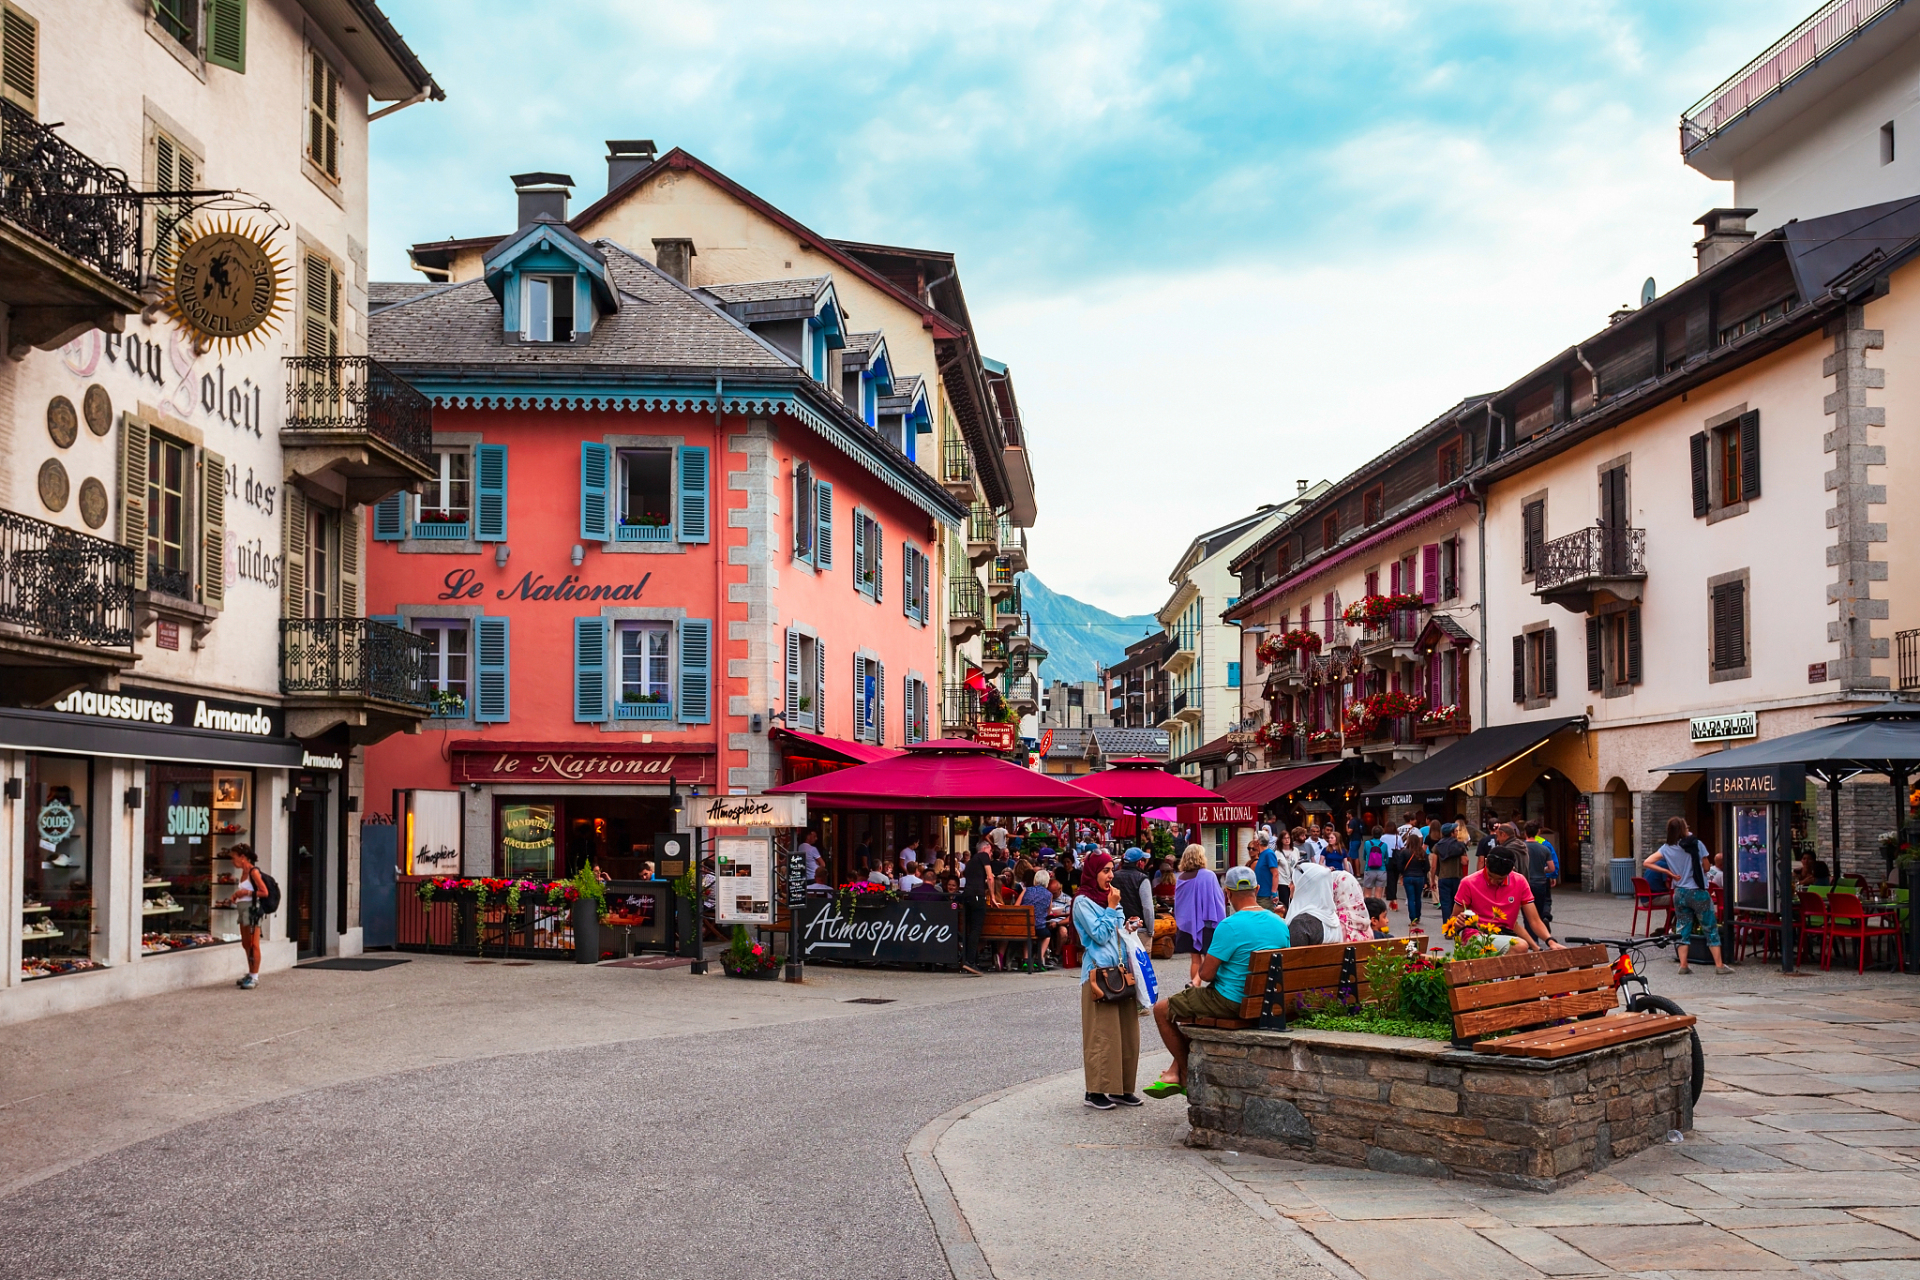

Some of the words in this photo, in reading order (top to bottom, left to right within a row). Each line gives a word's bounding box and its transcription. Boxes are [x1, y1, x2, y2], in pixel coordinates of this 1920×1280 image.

[180, 262, 233, 332] BEAUSOLEIL
[249, 260, 271, 315] GUIDES
[438, 568, 485, 600] Le
[496, 570, 652, 601] National
[194, 700, 271, 736] Armando
[1692, 717, 1753, 738] NAPAPIJRI
[302, 750, 343, 770] Armando
[493, 754, 520, 773] le
[531, 754, 677, 780] National
[1710, 777, 1721, 793] LE
[1724, 775, 1776, 792] BARTAVEL
[706, 797, 774, 825] Atmosphère
[1391, 794, 1413, 804] RICHARD
[42, 815, 70, 829] SOLDES
[166, 805, 210, 835] SOLDES
[1198, 806, 1209, 822] LE
[1213, 806, 1254, 821] NATIONAL
[415, 844, 459, 868] Atmosphère
[803, 902, 952, 957] Atmosphère
